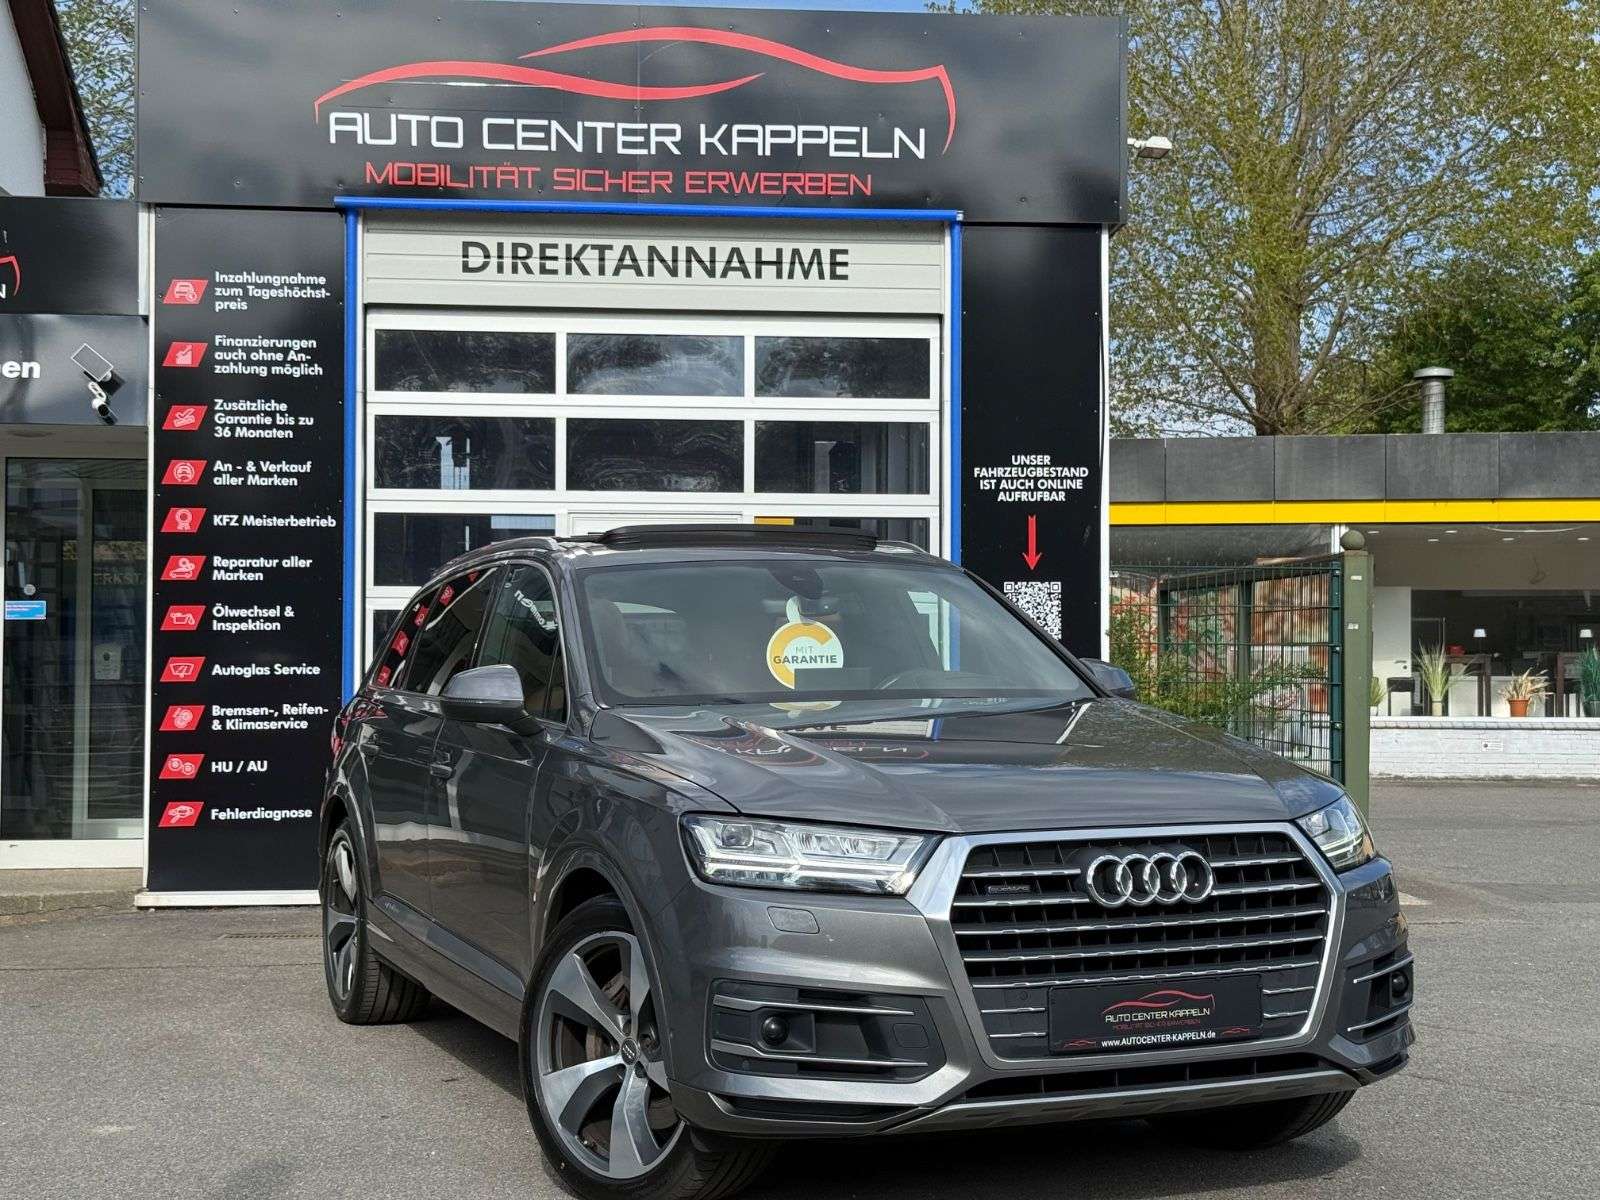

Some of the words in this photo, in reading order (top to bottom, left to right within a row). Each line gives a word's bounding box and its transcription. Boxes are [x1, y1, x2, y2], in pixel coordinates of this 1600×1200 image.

[329, 111, 464, 148] AUTO
[482, 118, 681, 156] CENTER
[700, 123, 925, 160] KAPPELN
[365, 161, 541, 191] MOBILITÄT
[552, 167, 673, 194] SICHER
[685, 171, 872, 197] ERWERBEN
[461, 241, 849, 281] DIREKTANNAHME
[214, 271, 327, 286] Inzahlungnahme
[214, 287, 243, 296] zum
[246, 285, 331, 300] Tageshöchst-
[215, 298, 248, 312] preis
[214, 335, 317, 350] Finanzierungen
[214, 348, 247, 361] auch
[250, 349, 284, 361] ohne
[287, 350, 312, 361] An-
[0, 360, 41, 379] en
[214, 362, 268, 377] zahlung
[271, 363, 323, 377] möglich
[214, 399, 288, 412] Zusätzliche
[214, 412, 273, 425] Garantie
[276, 413, 296, 425] bis
[298, 416, 314, 425] zu
[214, 426, 232, 438] 36
[235, 427, 294, 438] Monaten
[213, 460, 233, 472] An
[246, 460, 257, 472] &
[259, 461, 312, 473] Verkauf
[1012, 455, 1051, 465] UNSER
[213, 473, 244, 486] aller
[247, 474, 298, 486] Marken
[974, 467, 1089, 478] FAHRZEUGBESTAND
[980, 479, 997, 490] IST
[999, 479, 1034, 490] AUCH
[1037, 479, 1083, 490] ONLINE
[997, 491, 1066, 502] AUFRUFBAR
[213, 515, 239, 527] KFZ
[242, 515, 337, 528] Meisterbetrieb
[213, 556, 279, 570] Reparatur
[282, 556, 313, 568] aller
[212, 569, 264, 581] Marken
[212, 603, 281, 618] Ölwechsel
[284, 605, 295, 617] &
[212, 619, 281, 633] Inspektion
[773, 655, 838, 665] GARANTIE
[212, 663, 271, 678] Autoglas
[273, 663, 321, 675] Service
[212, 704, 279, 717] Bremsen-,
[282, 703, 329, 715] Reifen-
[212, 719, 222, 731] &
[225, 718, 309, 730] Klimaservice
[211, 761, 233, 773] HU
[247, 760, 268, 772] AU
[211, 807, 313, 821] Fehlerdiagnose
[1105, 1013, 1131, 1023] AUTO
[1132, 1010, 1168, 1021] CENTER
[1169, 1007, 1210, 1018] KAPPELN
